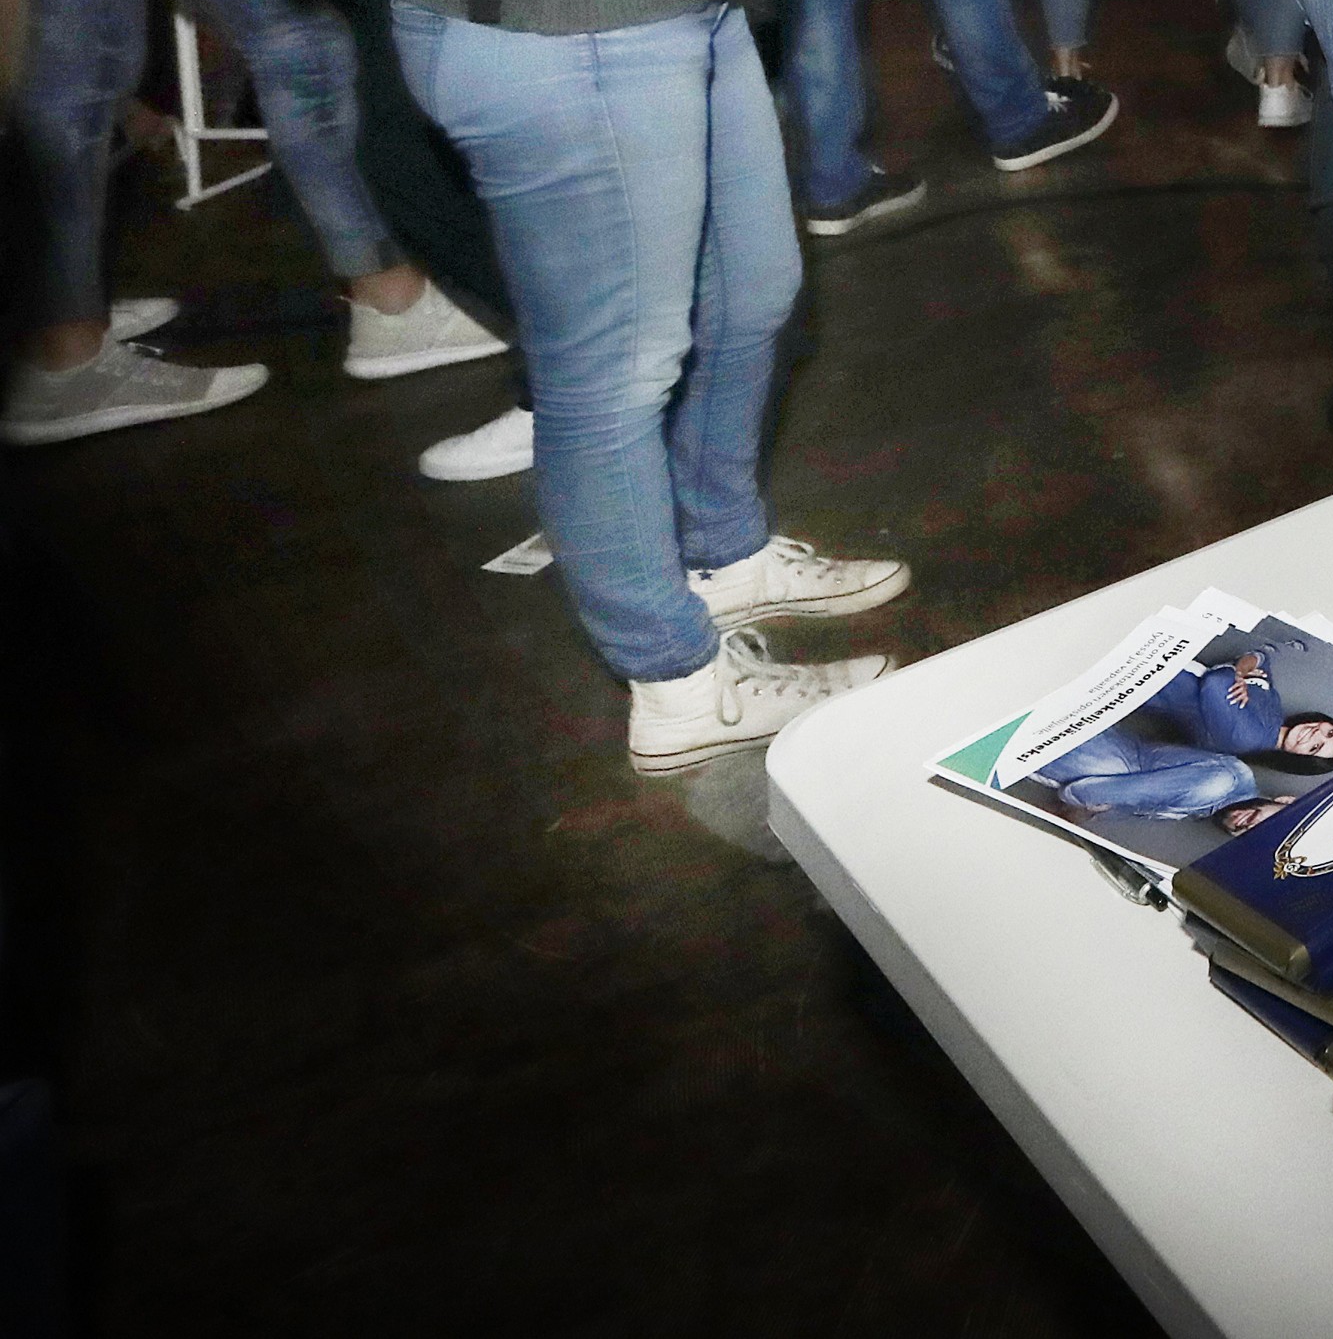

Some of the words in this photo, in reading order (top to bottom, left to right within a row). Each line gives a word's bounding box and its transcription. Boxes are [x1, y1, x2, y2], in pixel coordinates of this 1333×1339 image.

[1134, 627, 1164, 658] työssä
[1145, 646, 1159, 660] on
[1157, 631, 1175, 649] Pro
[1161, 636, 1187, 663] Liity
[1124, 654, 1136, 666] ja
[1087, 663, 1126, 696] vapaalla
[1091, 658, 1148, 704] luottokaveri
[1134, 661, 1163, 688] Pron
[1017, 684, 1134, 765] opiskelijajäseneksi
